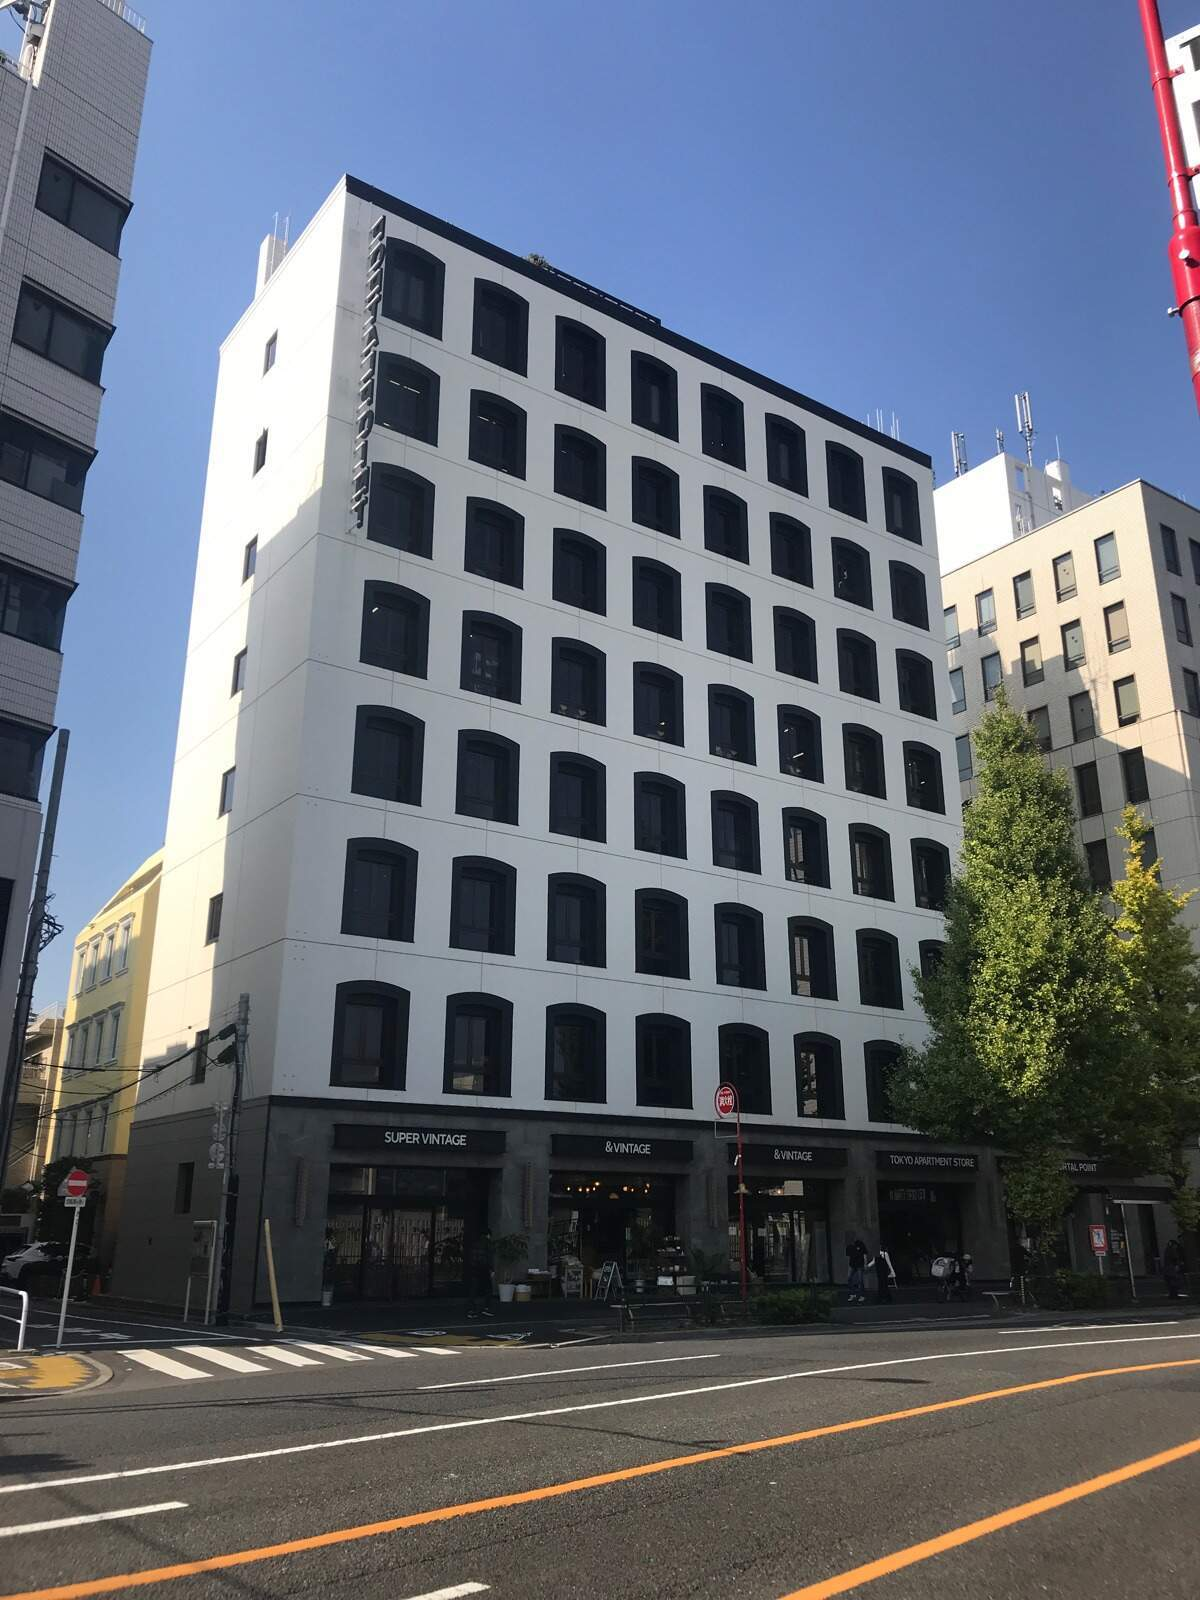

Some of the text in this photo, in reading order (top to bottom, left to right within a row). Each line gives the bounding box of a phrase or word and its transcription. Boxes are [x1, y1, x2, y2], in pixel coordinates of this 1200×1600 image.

[385, 1131, 467, 1146] SUPER VINTAGE
[890, 1155, 975, 1168] TOKYO APARTMENT STORE
[1079, 1162, 1097, 1172] POINT
